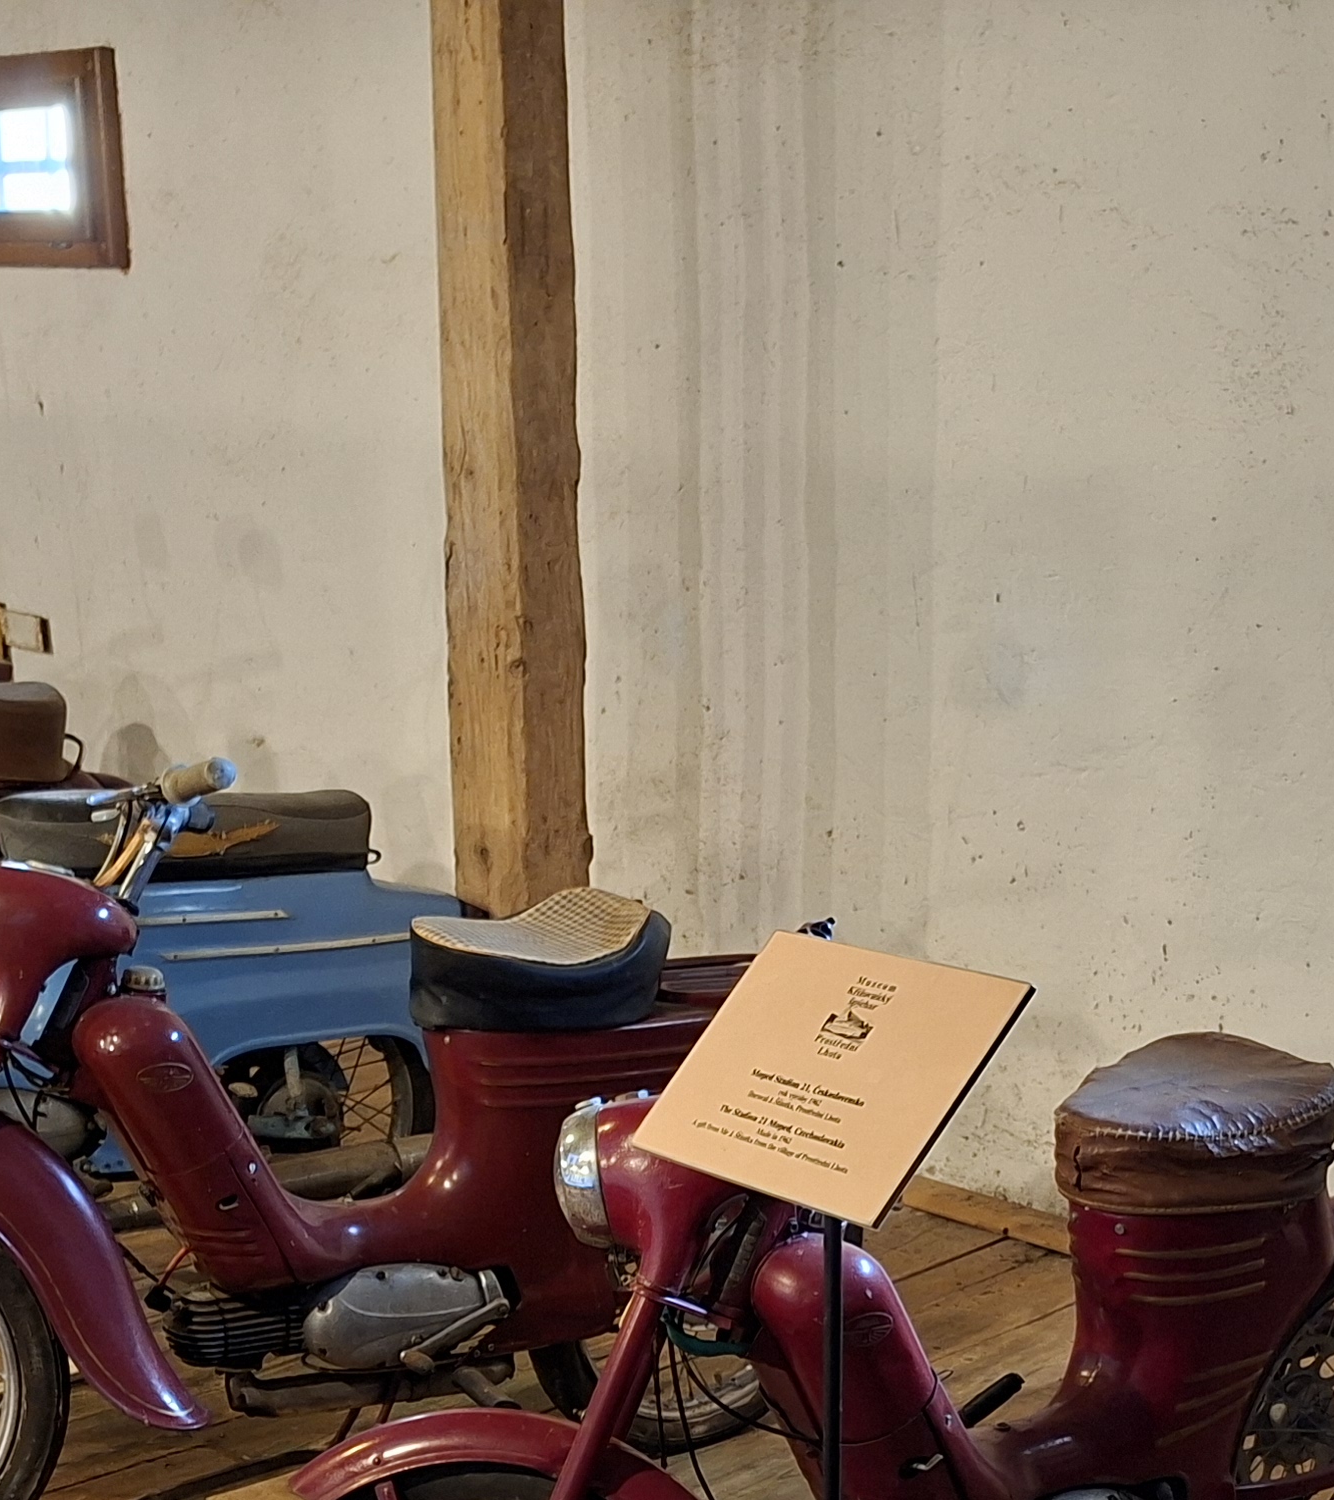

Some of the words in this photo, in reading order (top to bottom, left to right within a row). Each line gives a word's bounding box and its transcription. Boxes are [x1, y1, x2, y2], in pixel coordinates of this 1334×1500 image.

[817, 1046, 842, 1060] Lhota
[751, 1068, 776, 1081] Moped
[774, 1075, 800, 1089] Stadion
[800, 1083, 811, 1093] 21,
[720, 1104, 733, 1114] The
[757, 1116, 769, 1125] 21
